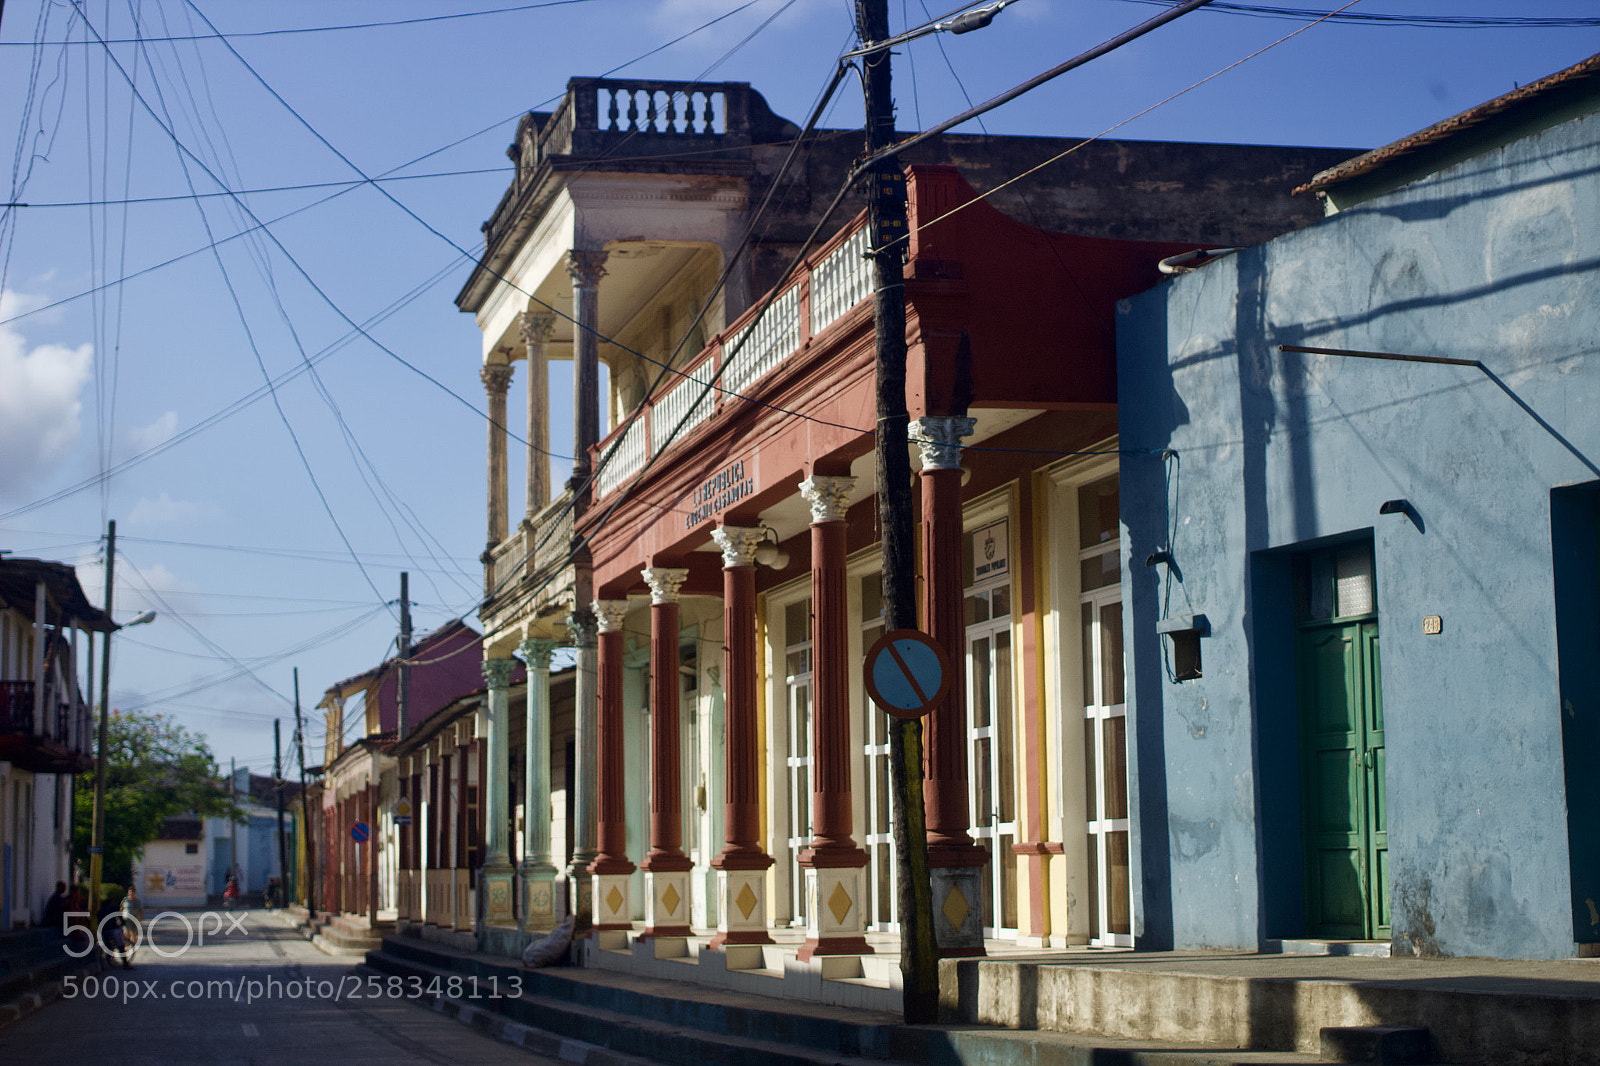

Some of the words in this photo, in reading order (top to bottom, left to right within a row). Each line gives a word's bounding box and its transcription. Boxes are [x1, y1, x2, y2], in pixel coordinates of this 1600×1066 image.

[686, 501, 712, 529] EUGENIO
[714, 477, 753, 513] CASANOVAS
[693, 487, 702, 508] LA
[703, 460, 744, 502] REPUBLICA
